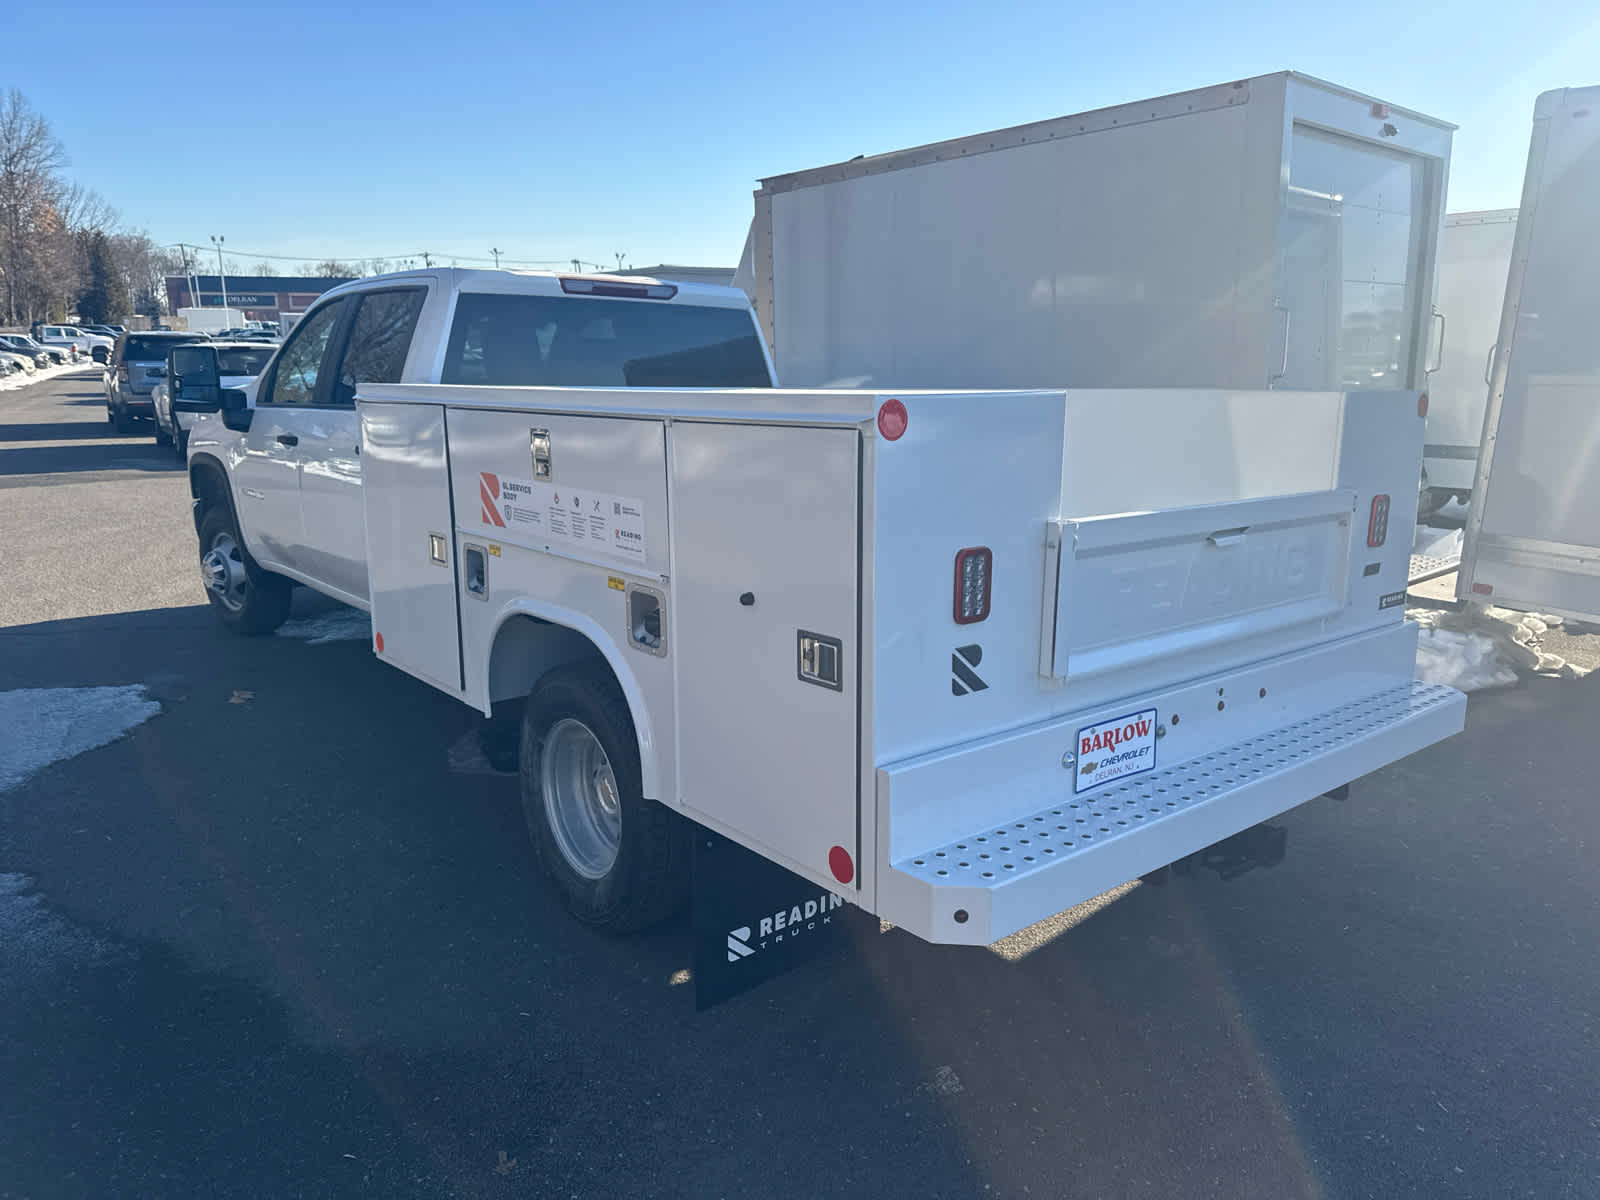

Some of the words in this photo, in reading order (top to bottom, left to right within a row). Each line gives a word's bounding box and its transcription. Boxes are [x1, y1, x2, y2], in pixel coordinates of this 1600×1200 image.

[509, 483, 531, 495] SERVICE
[1081, 719, 1152, 755] BARLOW
[1100, 745, 1152, 768] CHEVROLET
[760, 893, 842, 937] READIN
[760, 916, 831, 950] TRUCK
